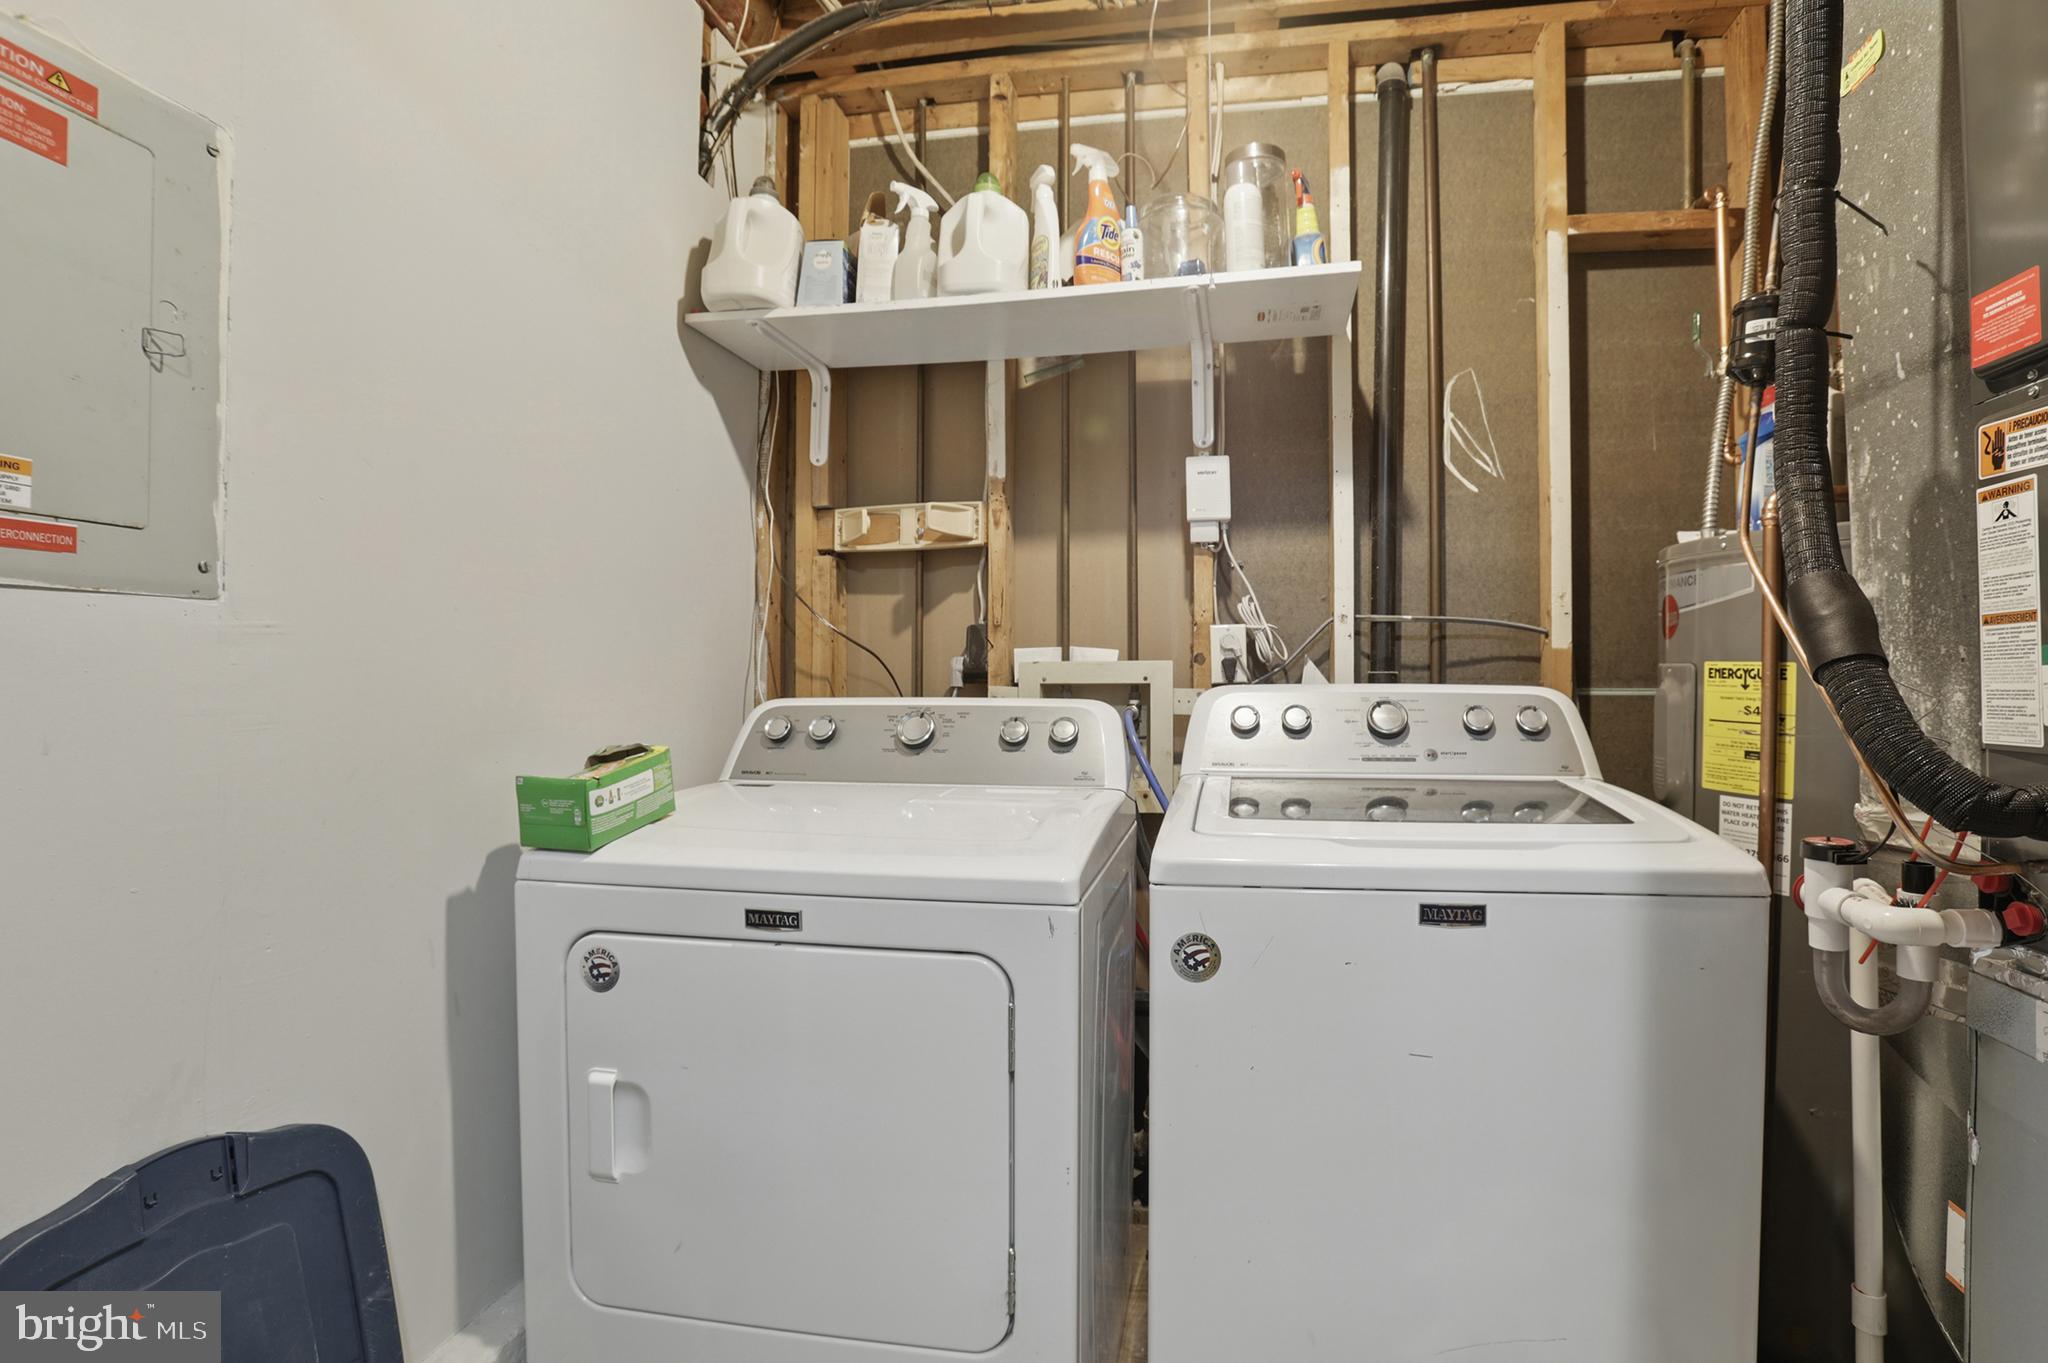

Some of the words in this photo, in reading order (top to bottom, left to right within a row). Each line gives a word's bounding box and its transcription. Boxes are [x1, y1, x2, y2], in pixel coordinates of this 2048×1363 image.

[1101, 223, 1119, 241] Tide
[1987, 481, 2031, 500] WARNING
[1721, 809, 1740, 817] WATER
[1723, 818, 1740, 826] PLACE
[747, 912, 798, 926] MAYTAG
[1423, 907, 1483, 921] MAYTAG
[1173, 934, 1216, 956] AMERICA
[583, 948, 619, 969] AMERICA
